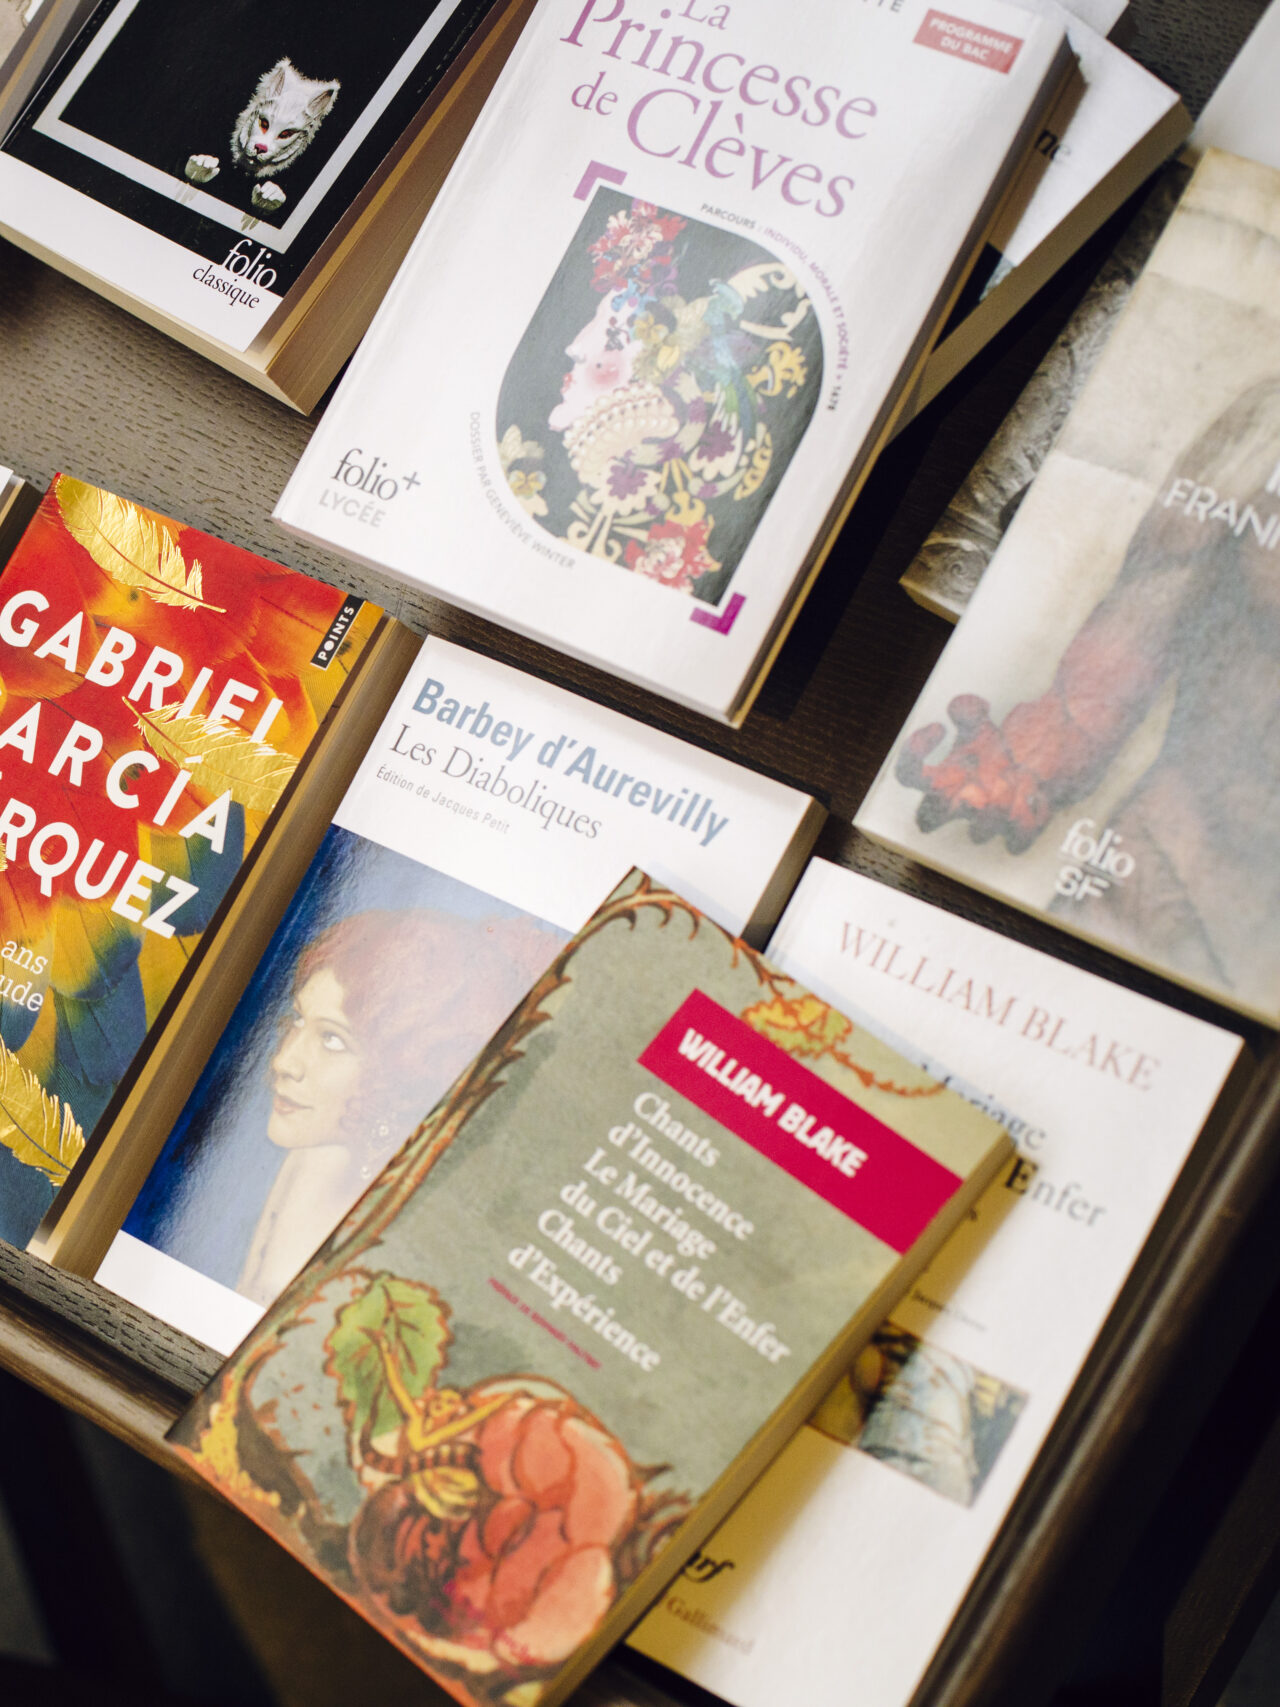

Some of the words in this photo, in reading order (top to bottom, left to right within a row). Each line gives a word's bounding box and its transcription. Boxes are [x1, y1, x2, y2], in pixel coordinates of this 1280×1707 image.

[678, 0, 729, 30] La
[929, 18, 1014, 54] PROGRAMME
[940, 36, 960, 50] DU
[963, 42, 990, 60] BAC
[560, 0, 877, 139] Princesse
[571, 71, 618, 115] de
[626, 88, 855, 218] Clèves
[192, 264, 260, 309] classique
[221, 239, 277, 289] folio
[700, 203, 756, 229] PARCOURS
[810, 262, 840, 304] MORALE
[471, 412, 484, 463] DOSSIER
[319, 488, 387, 528] LYCÉE
[477, 465, 492, 487] PAR
[1163, 477, 1280, 551] FRAN
[532, 539, 576, 569] WINTER
[318, 606, 354, 661] POINTS
[389, 723, 437, 767] Les
[441, 745, 603, 840] Diaboliques
[412, 677, 535, 762] Barbey
[536, 734, 730, 848] d'Aurevilly
[376, 764, 414, 791] Édition
[416, 785, 431, 798] de
[431, 792, 480, 821] Jacques
[481, 812, 510, 834] Petit
[1055, 865, 1110, 900] SF
[1060, 817, 1135, 878] folio
[1, 937, 49, 974] ans
[838, 919, 1017, 1028] WILLIAM
[1020, 1005, 1163, 1094] BLAKE
[633, 1091, 721, 1167] Chants
[677, 1027, 786, 1117] WILLIAM
[778, 1103, 869, 1178] BLAKE
[583, 1147, 618, 1184] Le
[614, 1171, 718, 1260] Mariage
[607, 1121, 755, 1241] d'Innocence
[537, 1208, 623, 1286] Chants
[560, 1180, 595, 1218] du
[596, 1204, 653, 1257] Ciel
[645, 1241, 675, 1276] et
[671, 1265, 707, 1301] de
[701, 1286, 793, 1366] l'Enfer
[507, 1244, 662, 1373] d'Expérience
